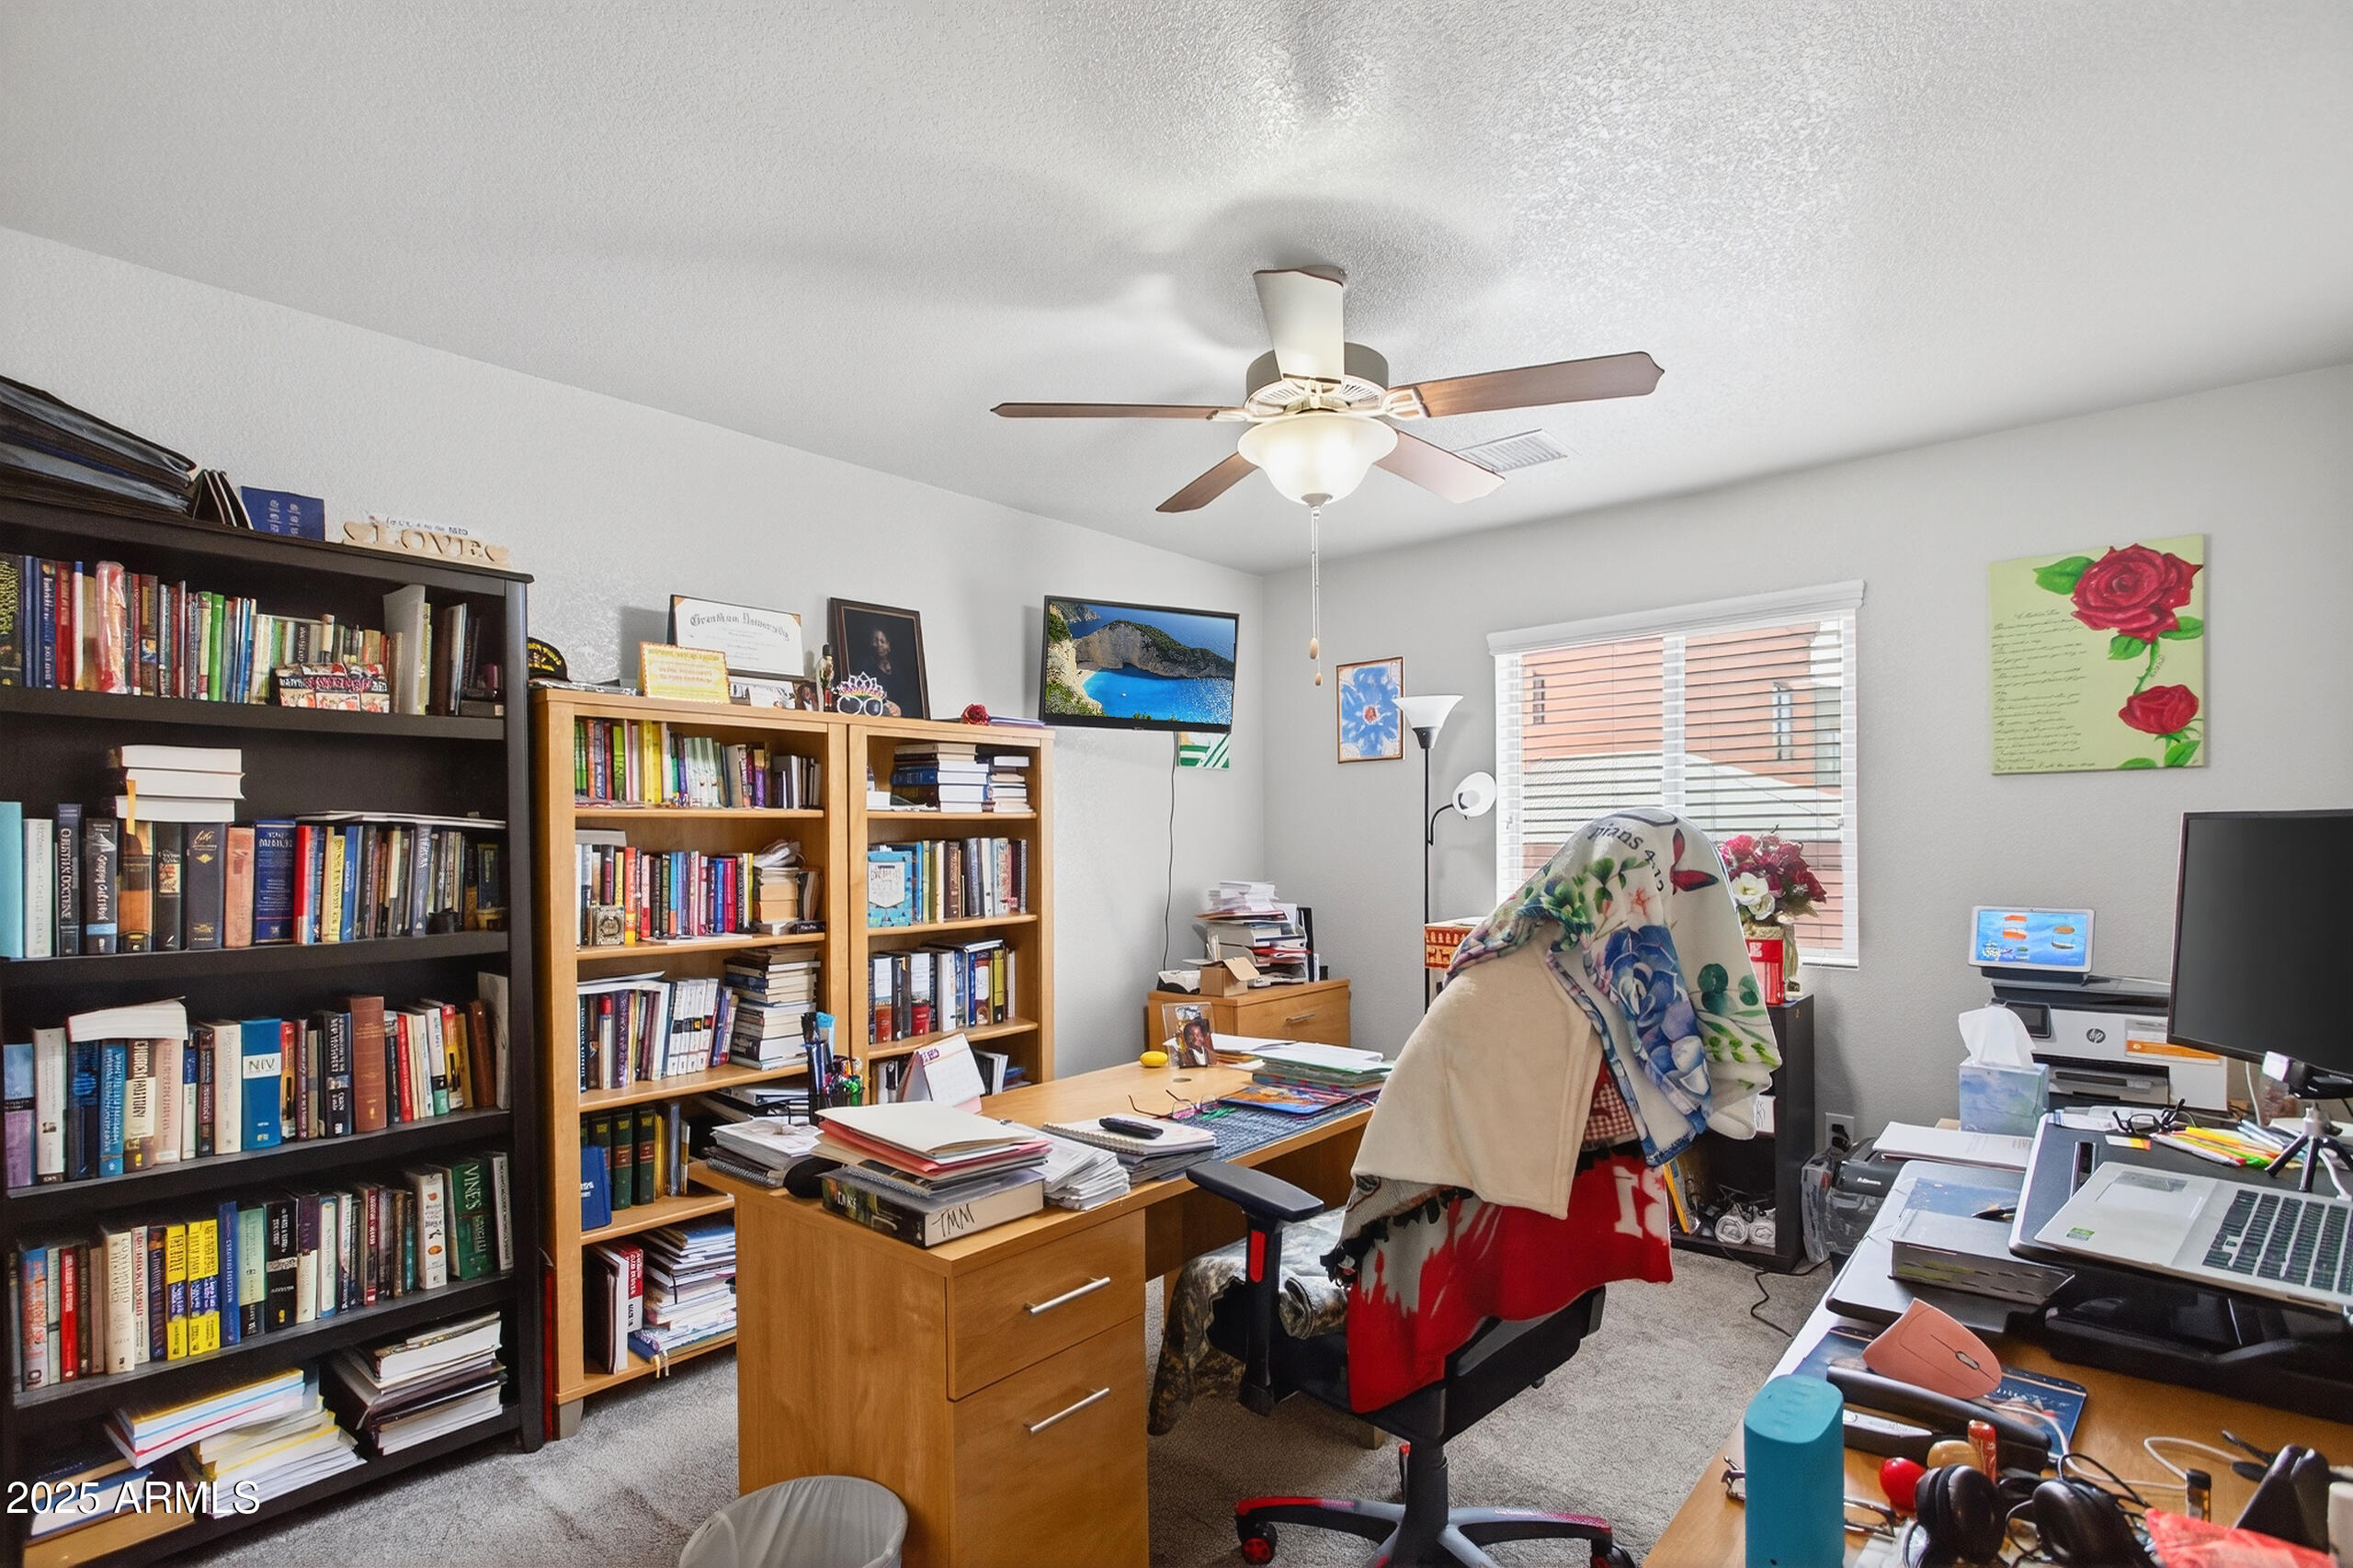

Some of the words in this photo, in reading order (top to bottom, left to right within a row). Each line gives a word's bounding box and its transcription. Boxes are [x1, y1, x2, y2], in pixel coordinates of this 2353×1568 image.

[368, 522, 484, 558] LOVE
[248, 1058, 276, 1072] NIV
[464, 1164, 483, 1210] VINES
